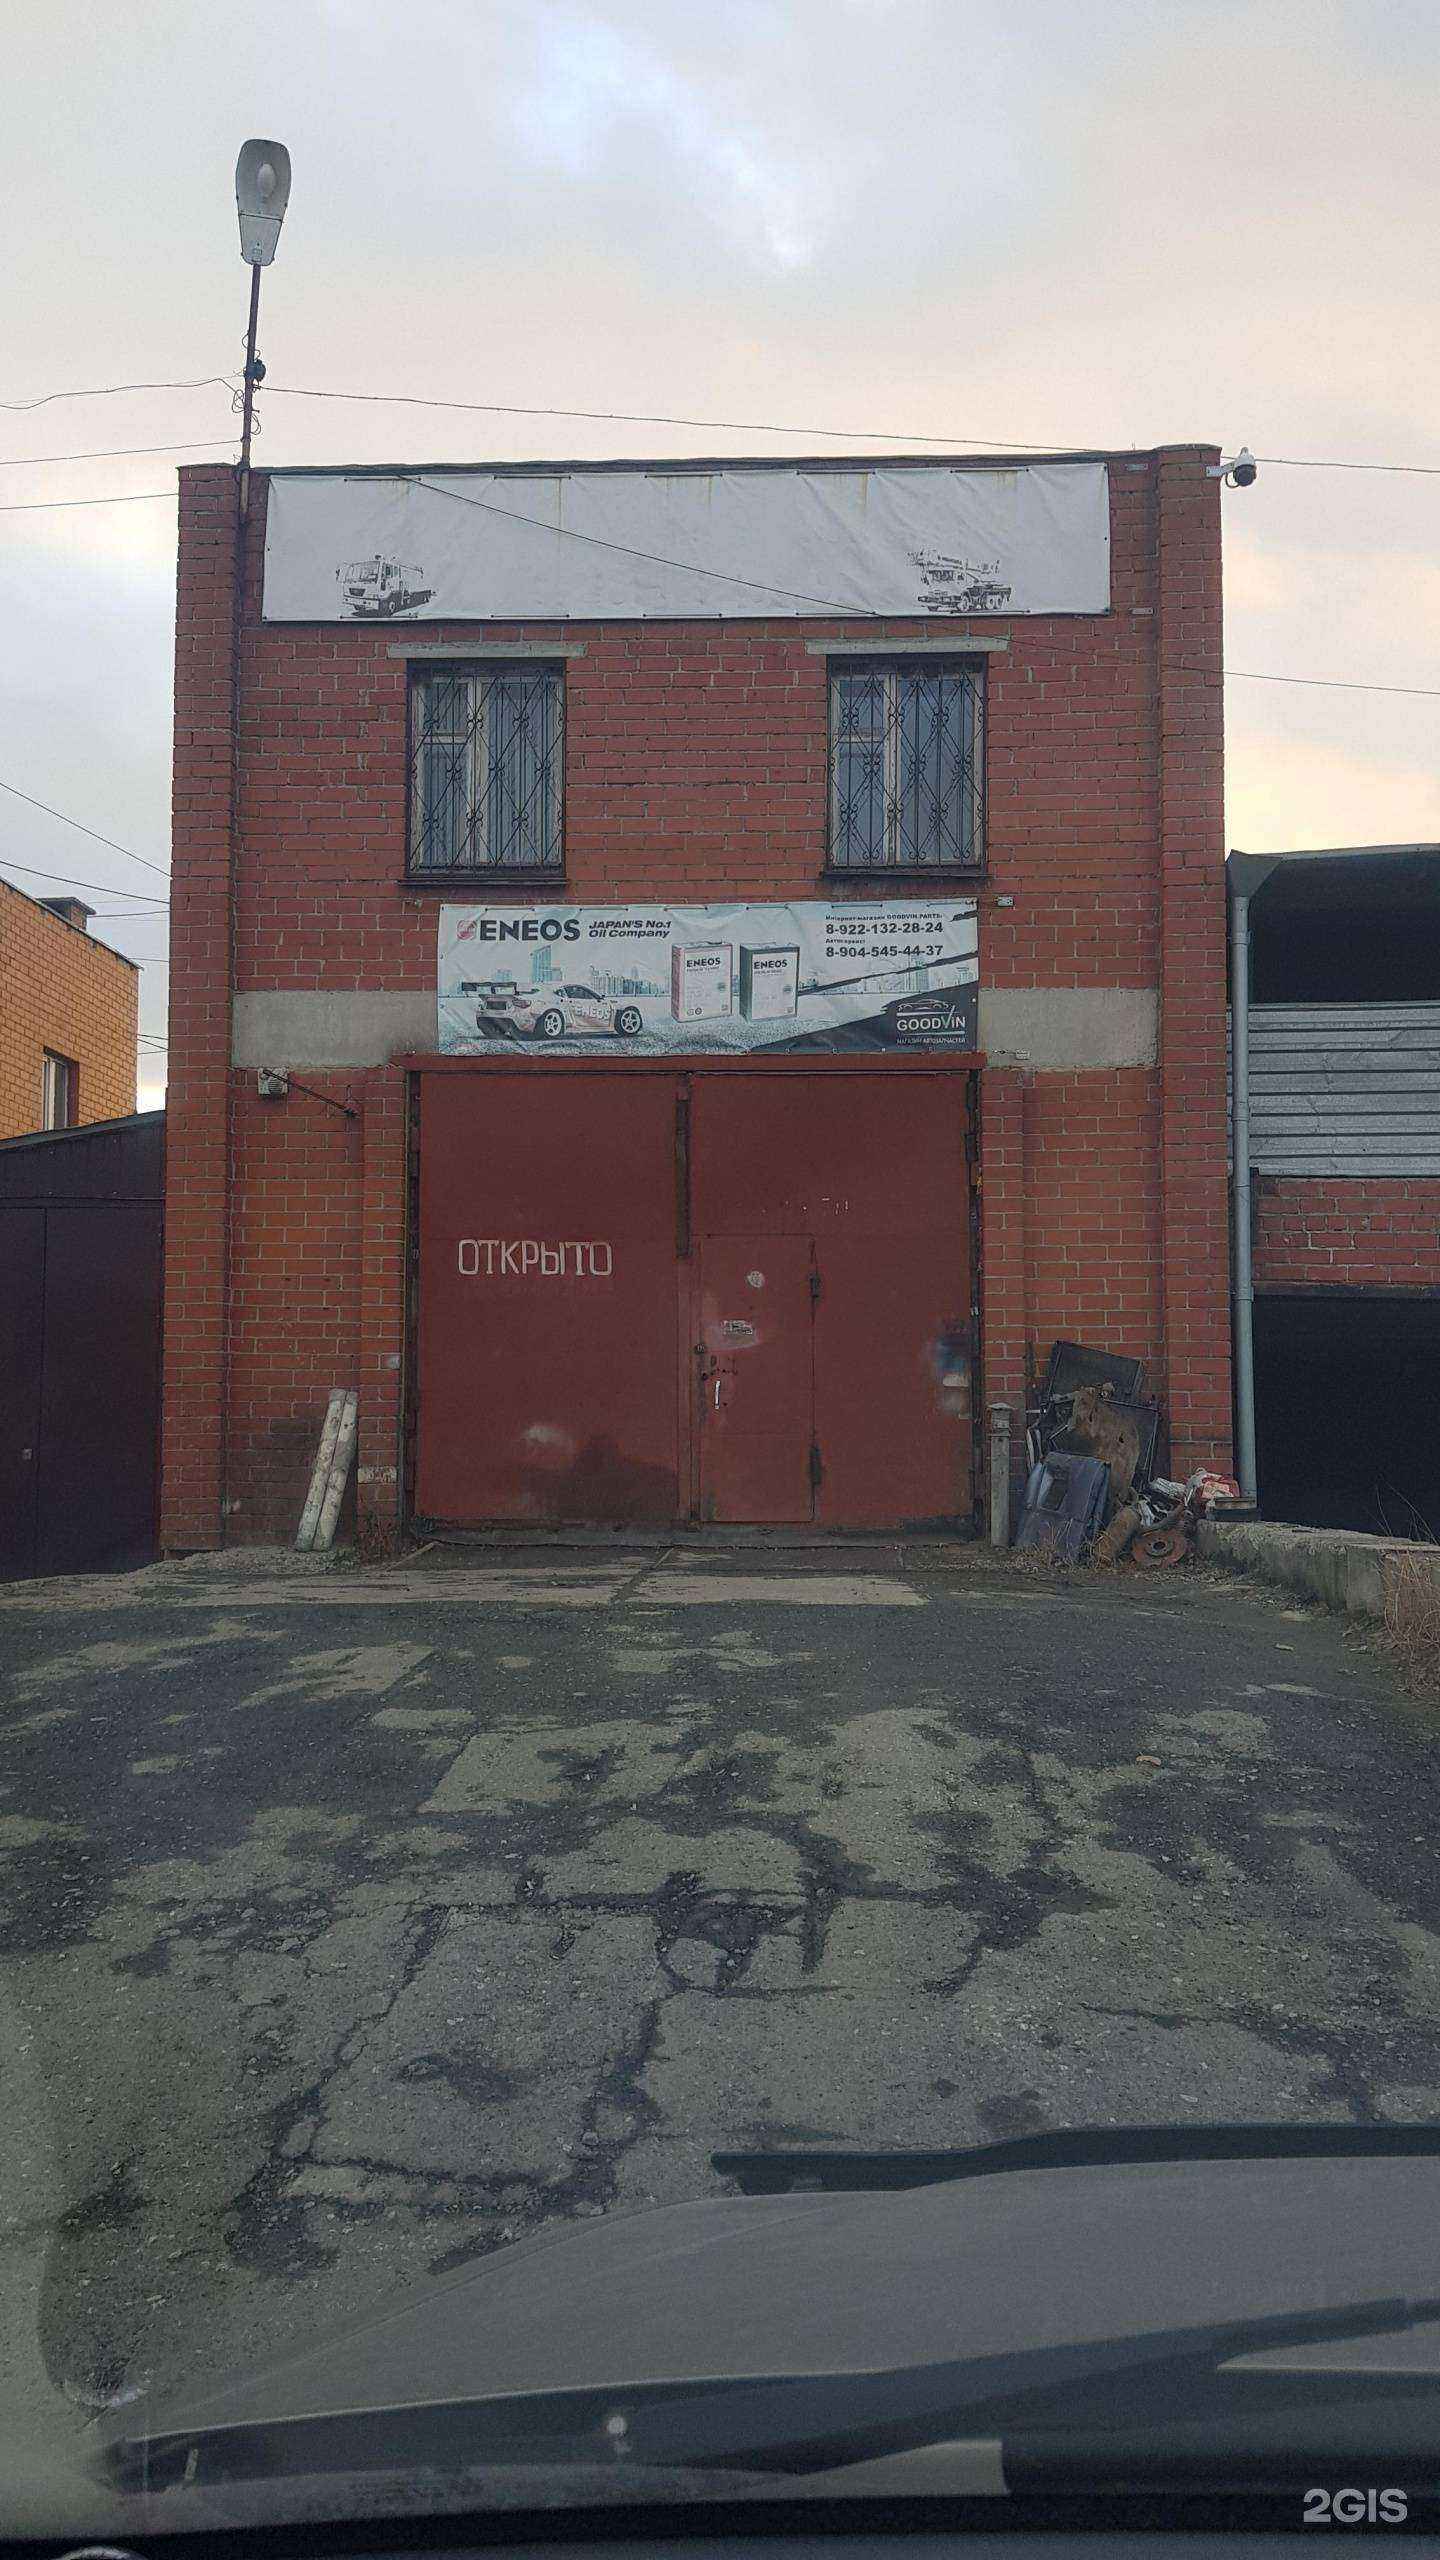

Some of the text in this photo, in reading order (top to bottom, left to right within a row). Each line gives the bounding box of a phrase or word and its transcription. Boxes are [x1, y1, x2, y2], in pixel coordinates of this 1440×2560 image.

[480, 918, 580, 941] ENEOS
[589, 920, 643, 930] JAPAN'S
[826, 922, 943, 935] 8-922-132-28-24
[588, 929, 670, 939] Oil Company
[826, 945, 943, 958] 8-904-545-44-37
[686, 957, 721, 968] ENEOS
[753, 959, 788, 970] ENEOS
[458, 1239, 613, 1276] ОТКРЫТО
